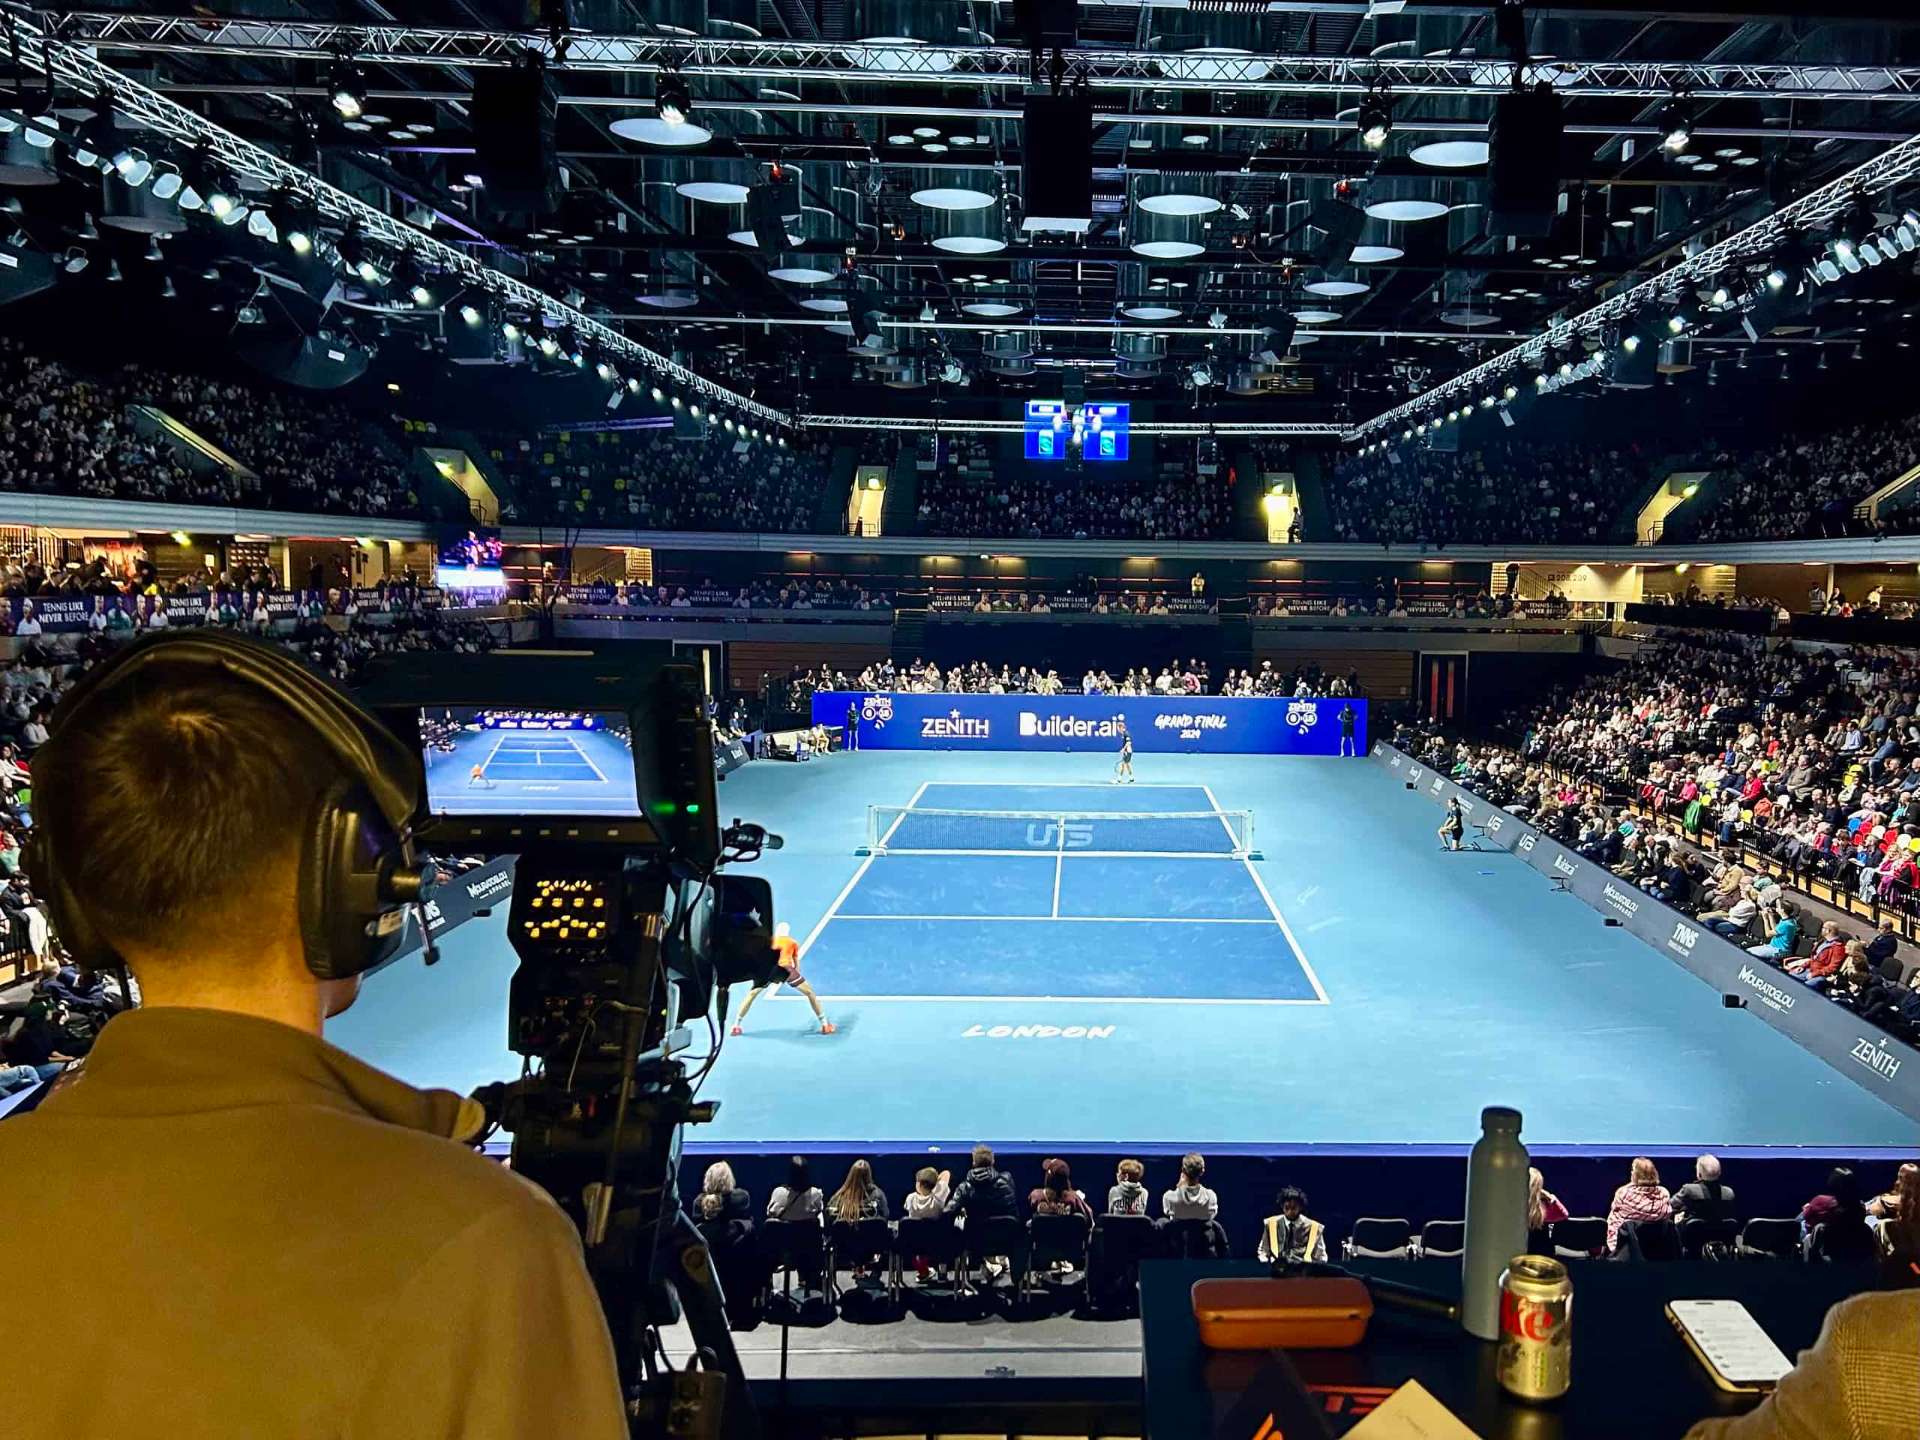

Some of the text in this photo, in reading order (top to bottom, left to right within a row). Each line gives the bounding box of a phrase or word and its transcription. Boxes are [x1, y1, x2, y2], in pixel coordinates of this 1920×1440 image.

[43, 601, 84, 612] TENNIS LIKE
[169, 597, 202, 607] TENNIS LIKE
[38, 611, 89, 624] NEVER BEFORE
[166, 606, 206, 617] NEVER BEFORE
[921, 718, 989, 735] ZENITH
[1019, 711, 1118, 737] Builder.ai
[1154, 714, 1228, 730] GRAND FINAL
[1738, 964, 1796, 1009] MOURATOGLOU
[960, 1023, 1117, 1040] LONDON
[1851, 1037, 1901, 1078] ZENITH
